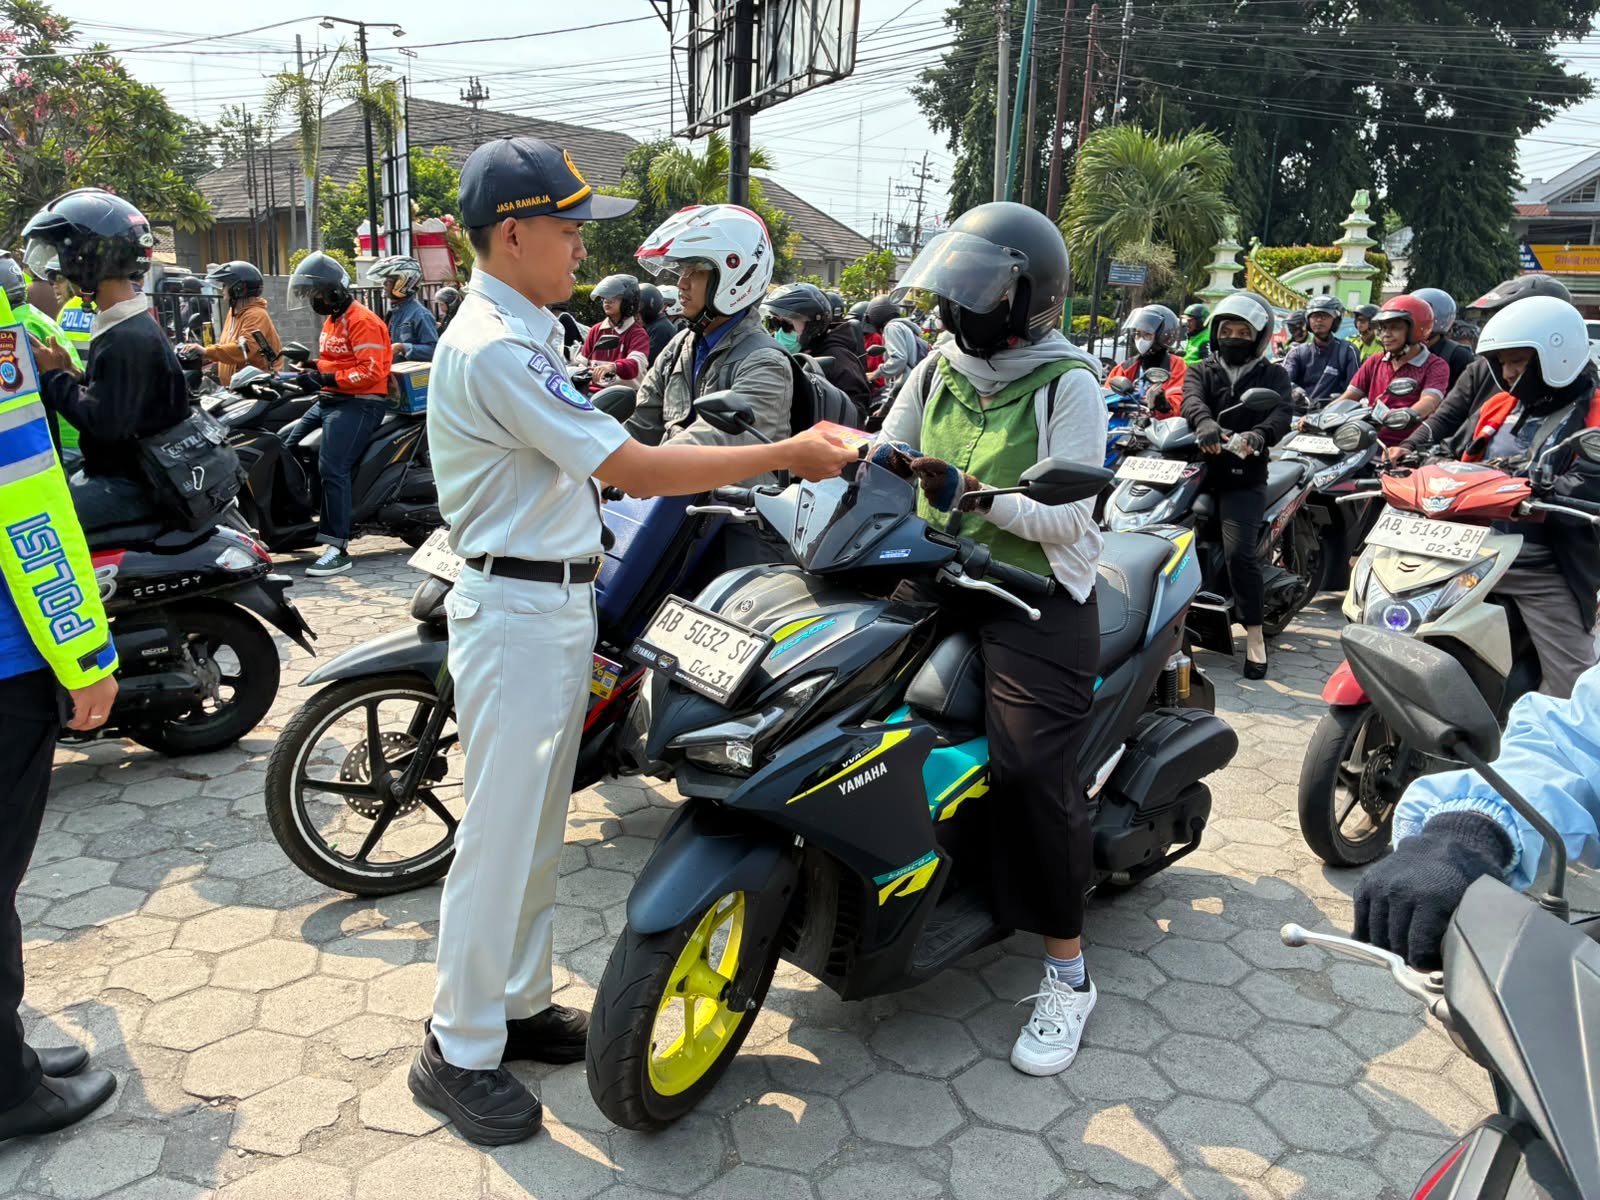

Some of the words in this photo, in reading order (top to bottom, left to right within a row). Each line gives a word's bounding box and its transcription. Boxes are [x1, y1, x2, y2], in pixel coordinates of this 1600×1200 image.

[496, 201, 515, 213] JASA
[515, 194, 551, 209] RAHARJA
[1379, 517, 1402, 531] AB
[1409, 521, 1452, 539] 5149
[1460, 529, 1485, 545] BH
[6, 512, 96, 645] POLISI
[133, 575, 201, 597] SCOOPY
[656, 608, 684, 633] AB
[684, 619, 730, 653] 5032
[728, 639, 758, 665] SV
[838, 761, 888, 796] YAMAHA
